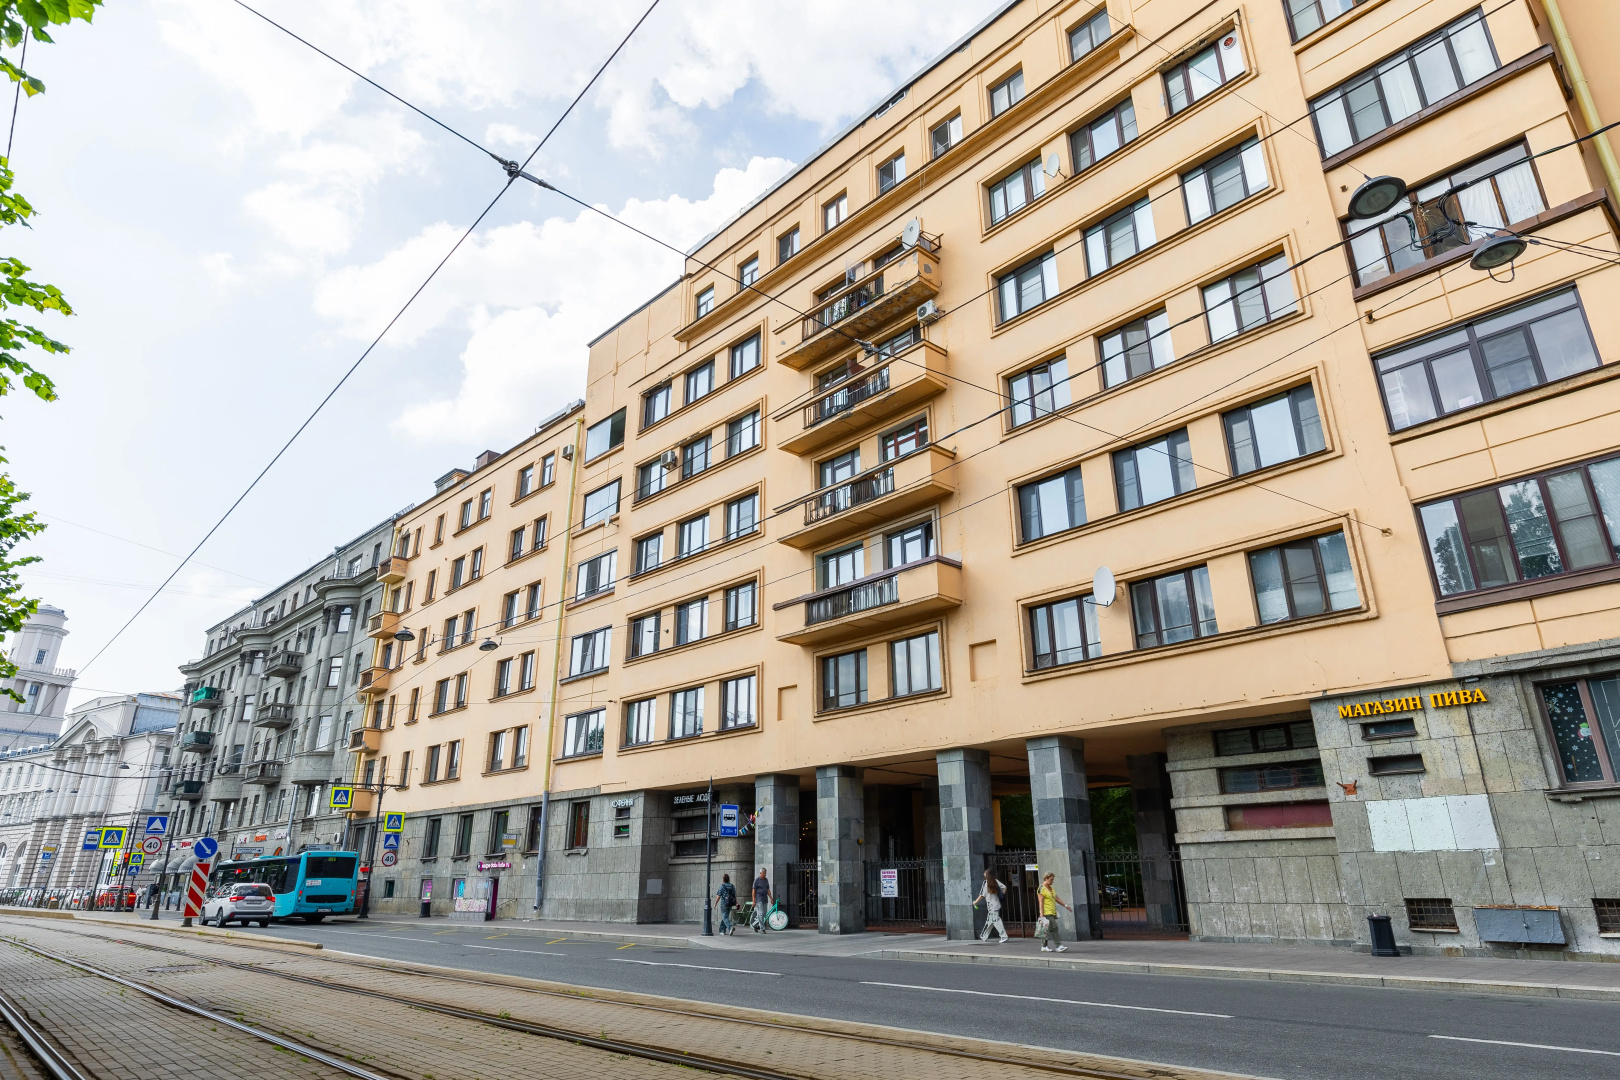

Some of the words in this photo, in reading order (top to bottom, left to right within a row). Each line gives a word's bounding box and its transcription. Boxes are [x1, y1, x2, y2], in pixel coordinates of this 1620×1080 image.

[1337, 695, 1423, 719] МАГАЗИН
[1428, 687, 1488, 708] ПИВА
[146, 841, 158, 849] 40
[385, 855, 394, 863] 40
